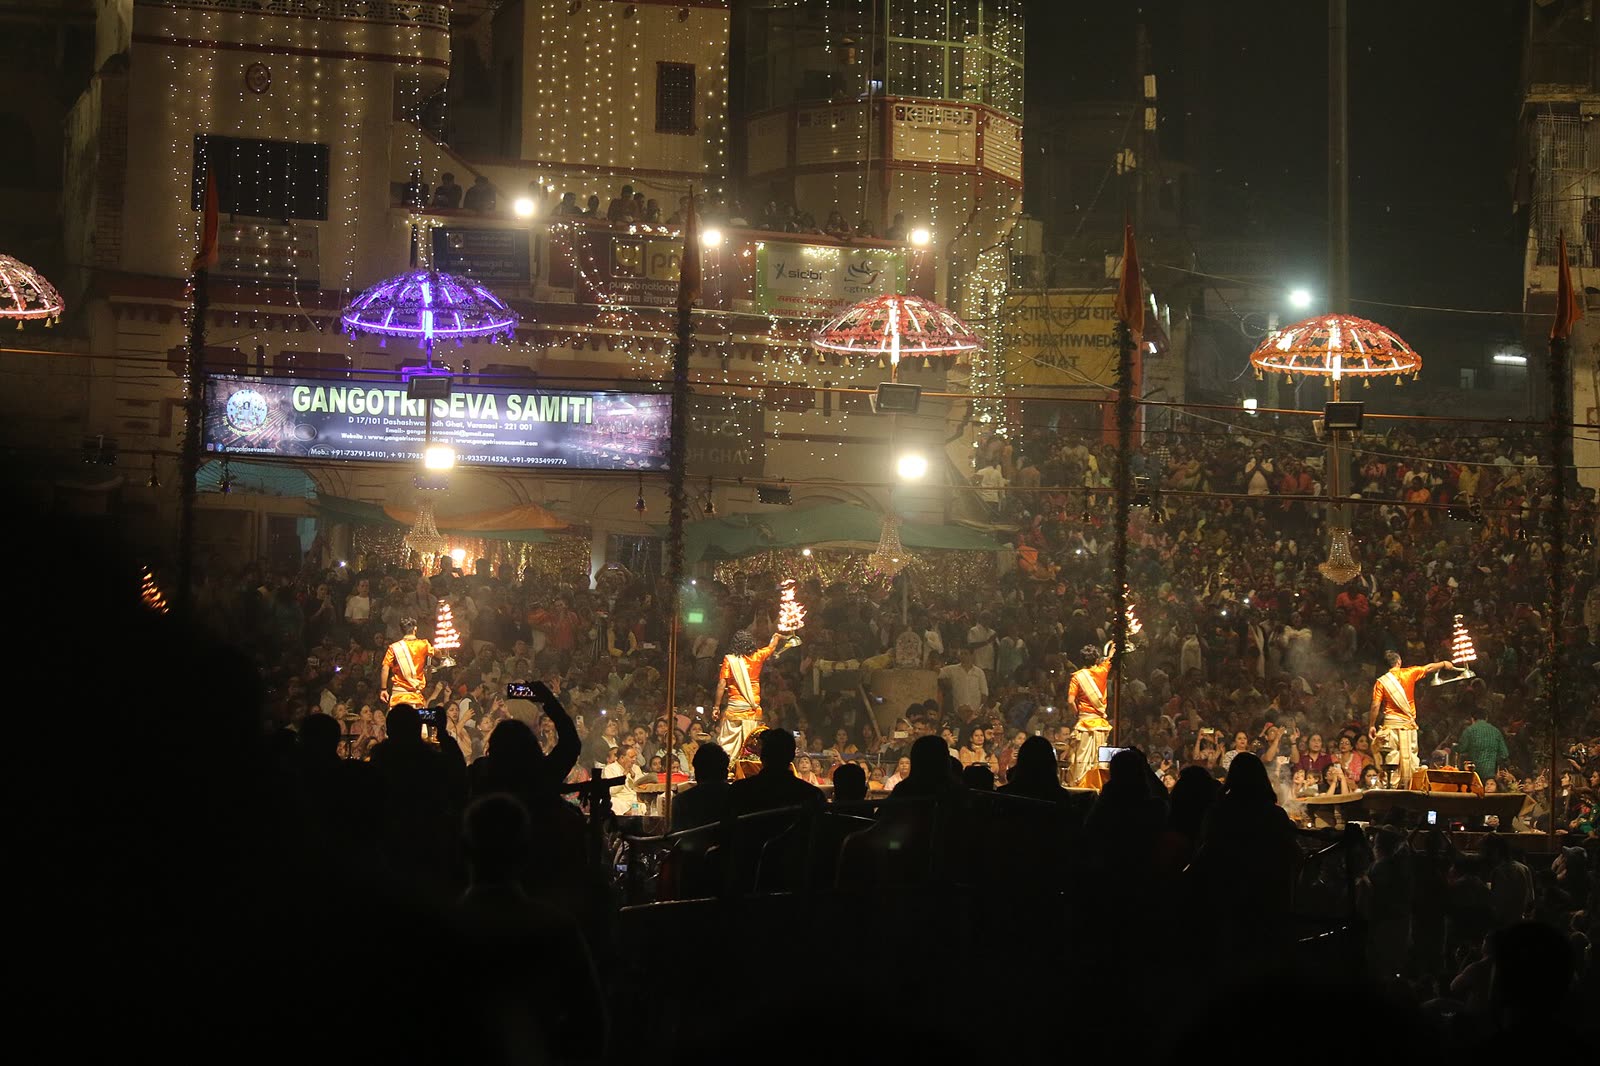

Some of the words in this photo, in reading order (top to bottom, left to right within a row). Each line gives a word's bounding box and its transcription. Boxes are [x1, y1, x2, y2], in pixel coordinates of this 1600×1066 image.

[651, 252, 680, 274] pn
[788, 269, 823, 281] sidbi
[609, 281, 641, 290] punjab
[642, 282, 679, 292] national
[1003, 332, 1114, 348] DASHASHWMED
[1033, 354, 1080, 369] GHAT
[292, 385, 425, 417] GANGOTRI
[432, 392, 499, 420] SEVA
[506, 394, 593, 424] SAMITI
[348, 416, 354, 424] D
[356, 416, 381, 426] 17/101
[466, 420, 498, 430] Varanasi
[519, 423, 533, 431] 001
